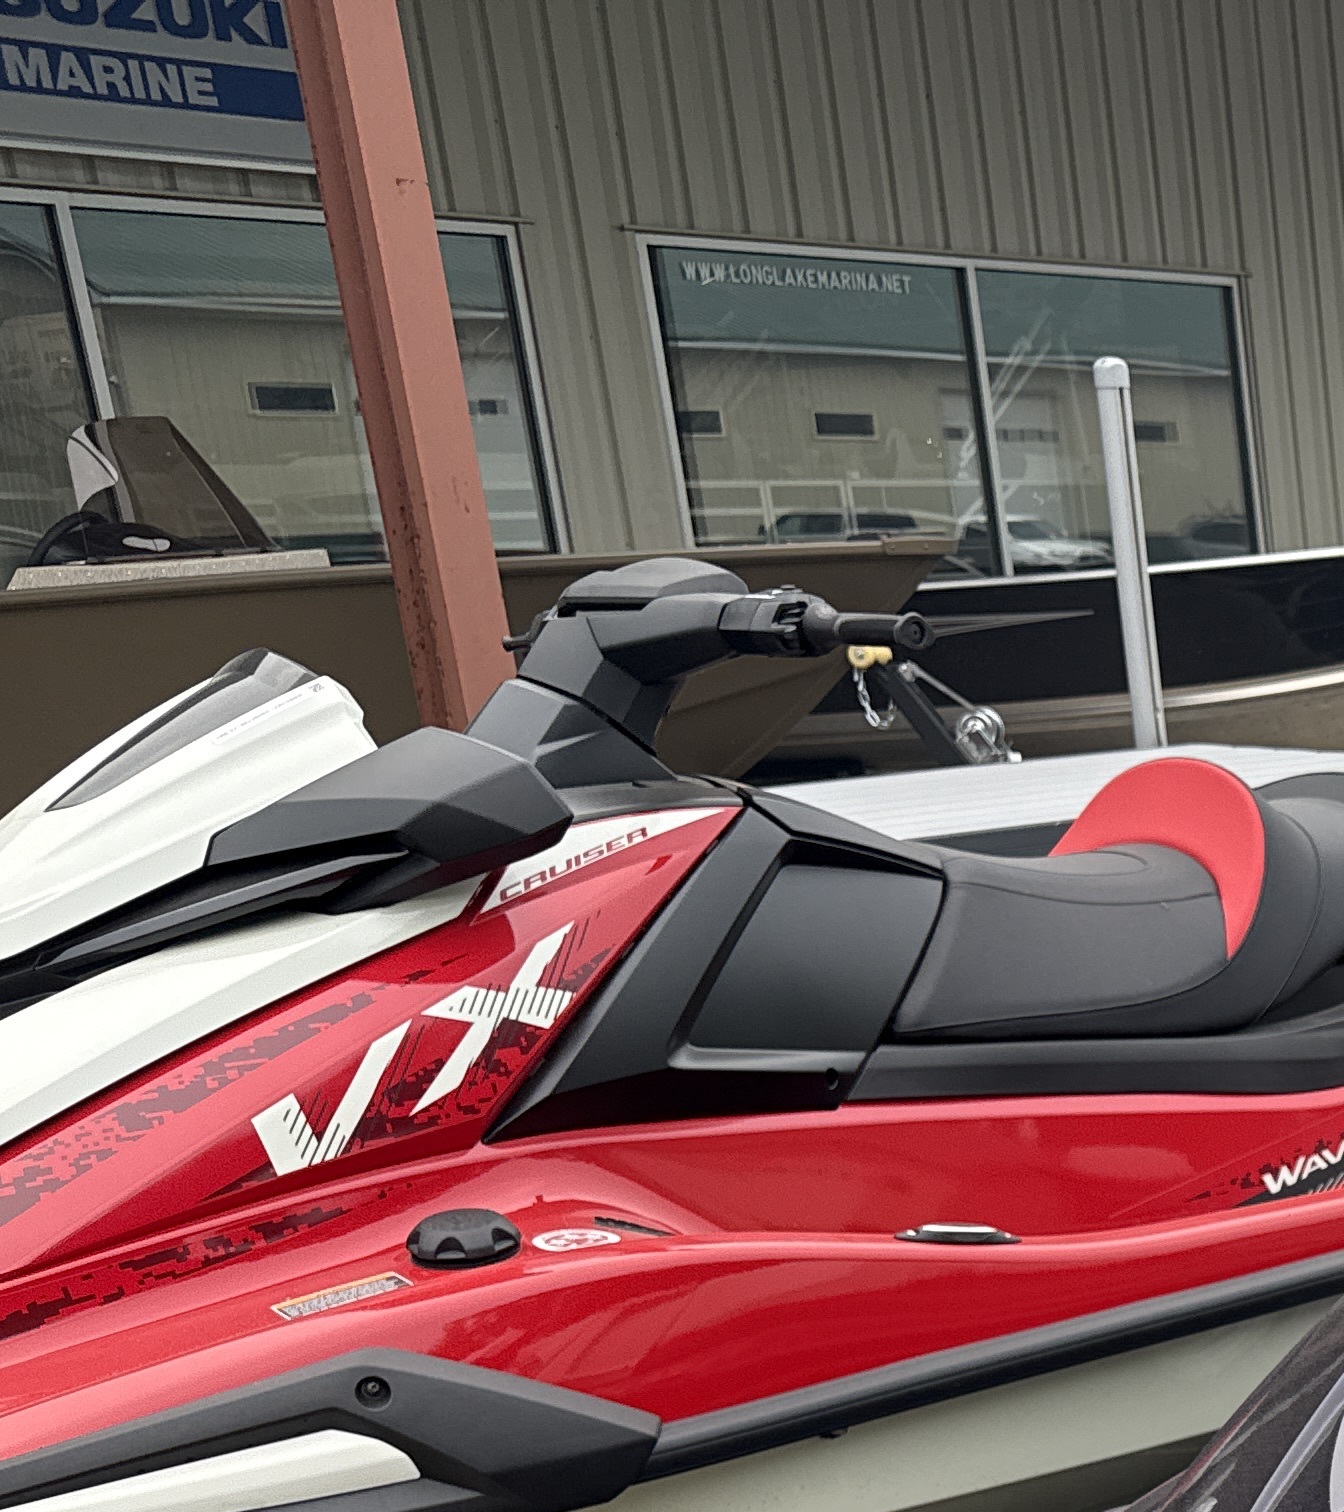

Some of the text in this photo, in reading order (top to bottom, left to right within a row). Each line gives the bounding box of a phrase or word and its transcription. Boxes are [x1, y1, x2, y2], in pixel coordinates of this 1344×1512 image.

[0, 44, 219, 107] MARINE
[500, 826, 648, 901] CRUISER
[251, 920, 577, 1177] VX
